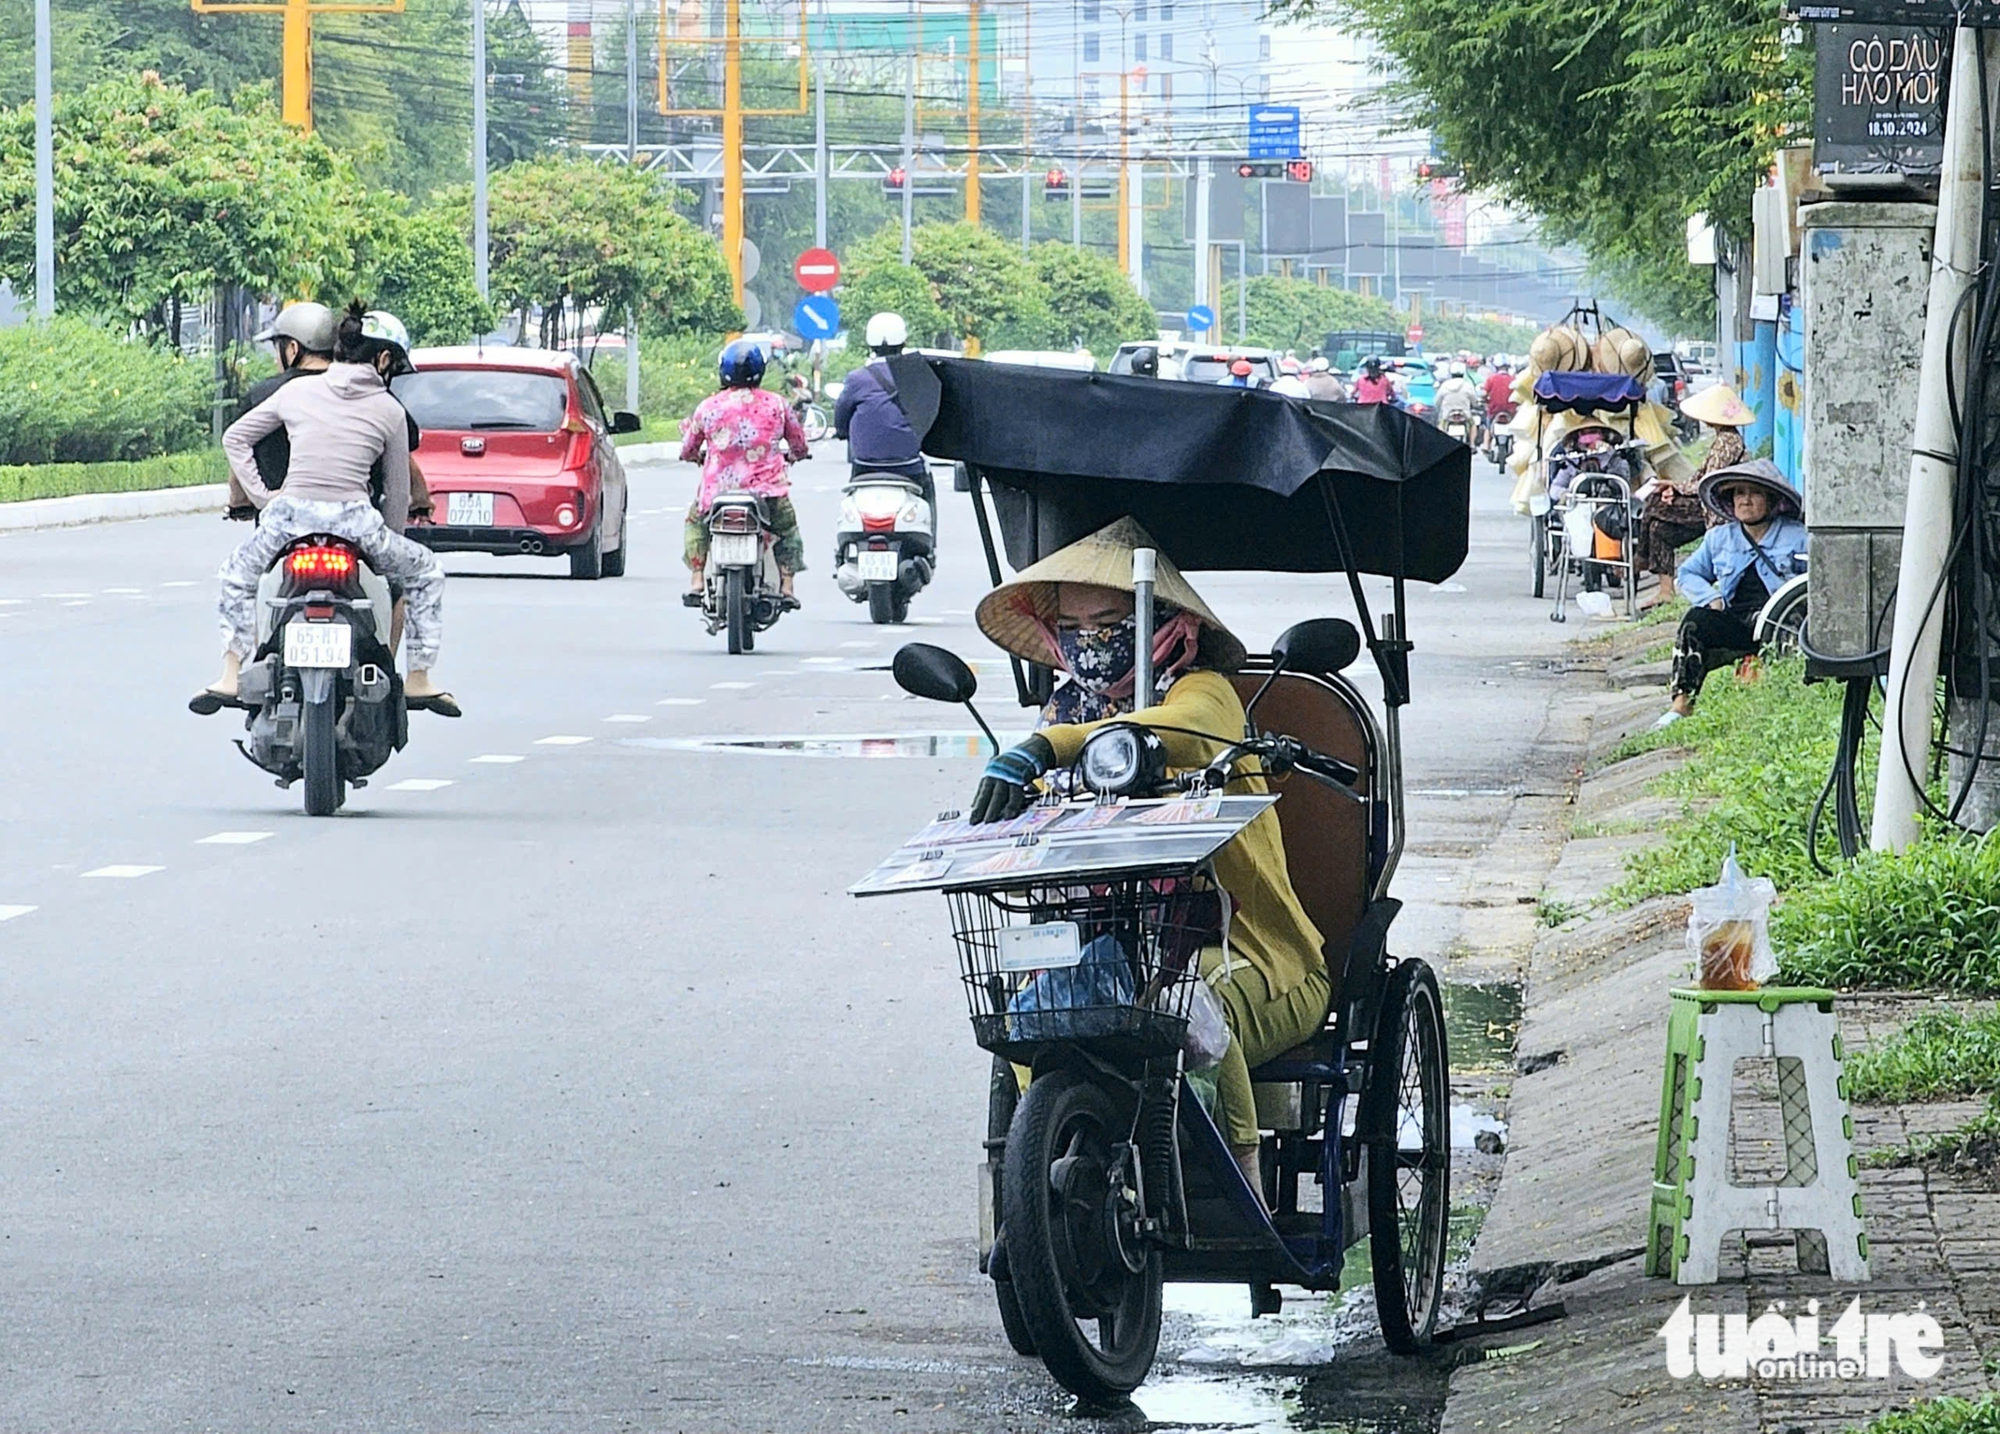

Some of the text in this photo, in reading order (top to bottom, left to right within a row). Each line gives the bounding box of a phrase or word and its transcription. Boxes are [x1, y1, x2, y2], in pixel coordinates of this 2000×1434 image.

[1850, 33, 1940, 73] CÔ DÂU
[1868, 121, 1928, 136] 18.10.2024
